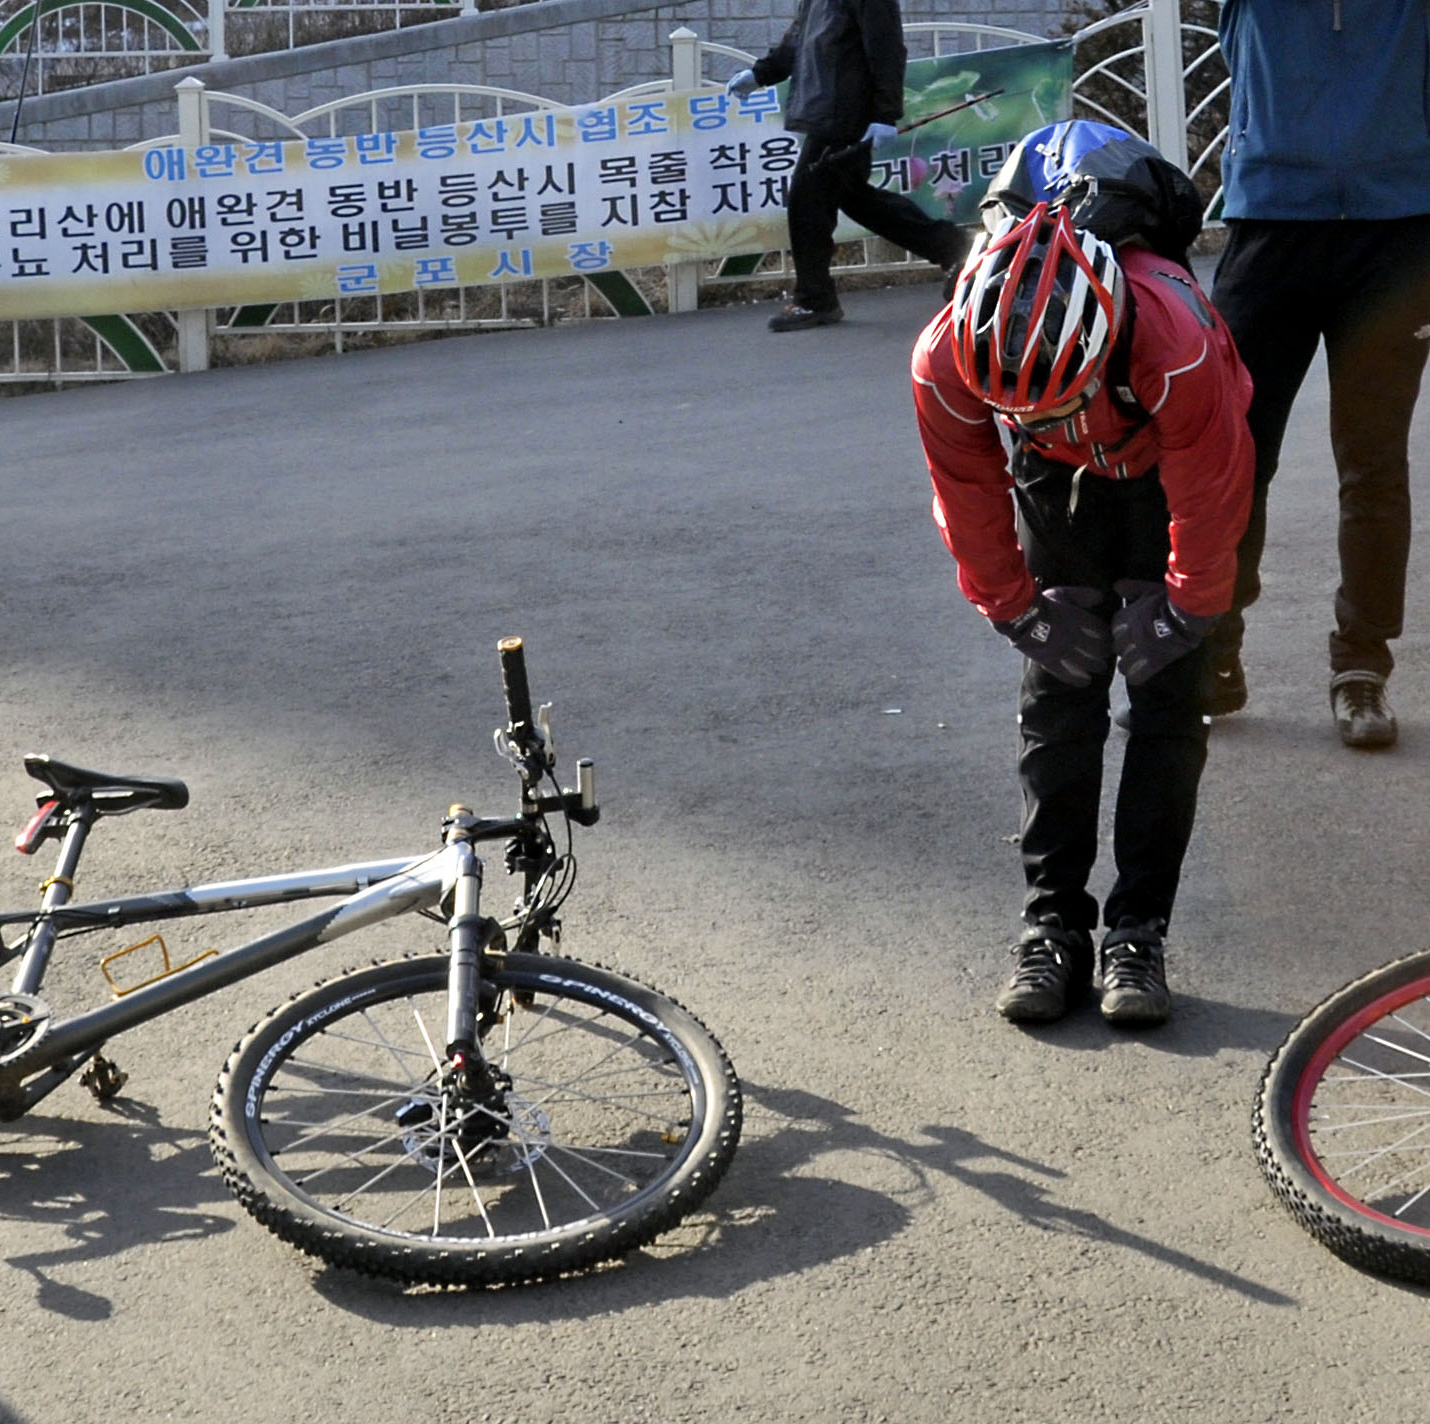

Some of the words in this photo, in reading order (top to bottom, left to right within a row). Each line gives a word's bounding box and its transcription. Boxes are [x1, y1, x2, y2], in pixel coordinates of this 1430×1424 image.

[144, 136, 284, 182] 애완견
[304, 131, 396, 171] 동반
[416, 113, 557, 160] 등산시
[576, 100, 668, 144] 협조
[688, 86, 782, 131] 당부
[166, 188, 305, 230] 애완견
[327, 178, 419, 218] 동반
[437, 161, 577, 209] 등산시
[598, 149, 689, 188] 목줄
[707, 136, 799, 175] 착용
[70, 236, 210, 274] 처리를
[229, 224, 322, 264] 위한
[341, 200, 579, 254] 비닐봉투를
[599, 190, 691, 229] 지참
[244, 1019, 305, 1119] SPINERGY
[305, 996, 353, 1027] XYCLONE
